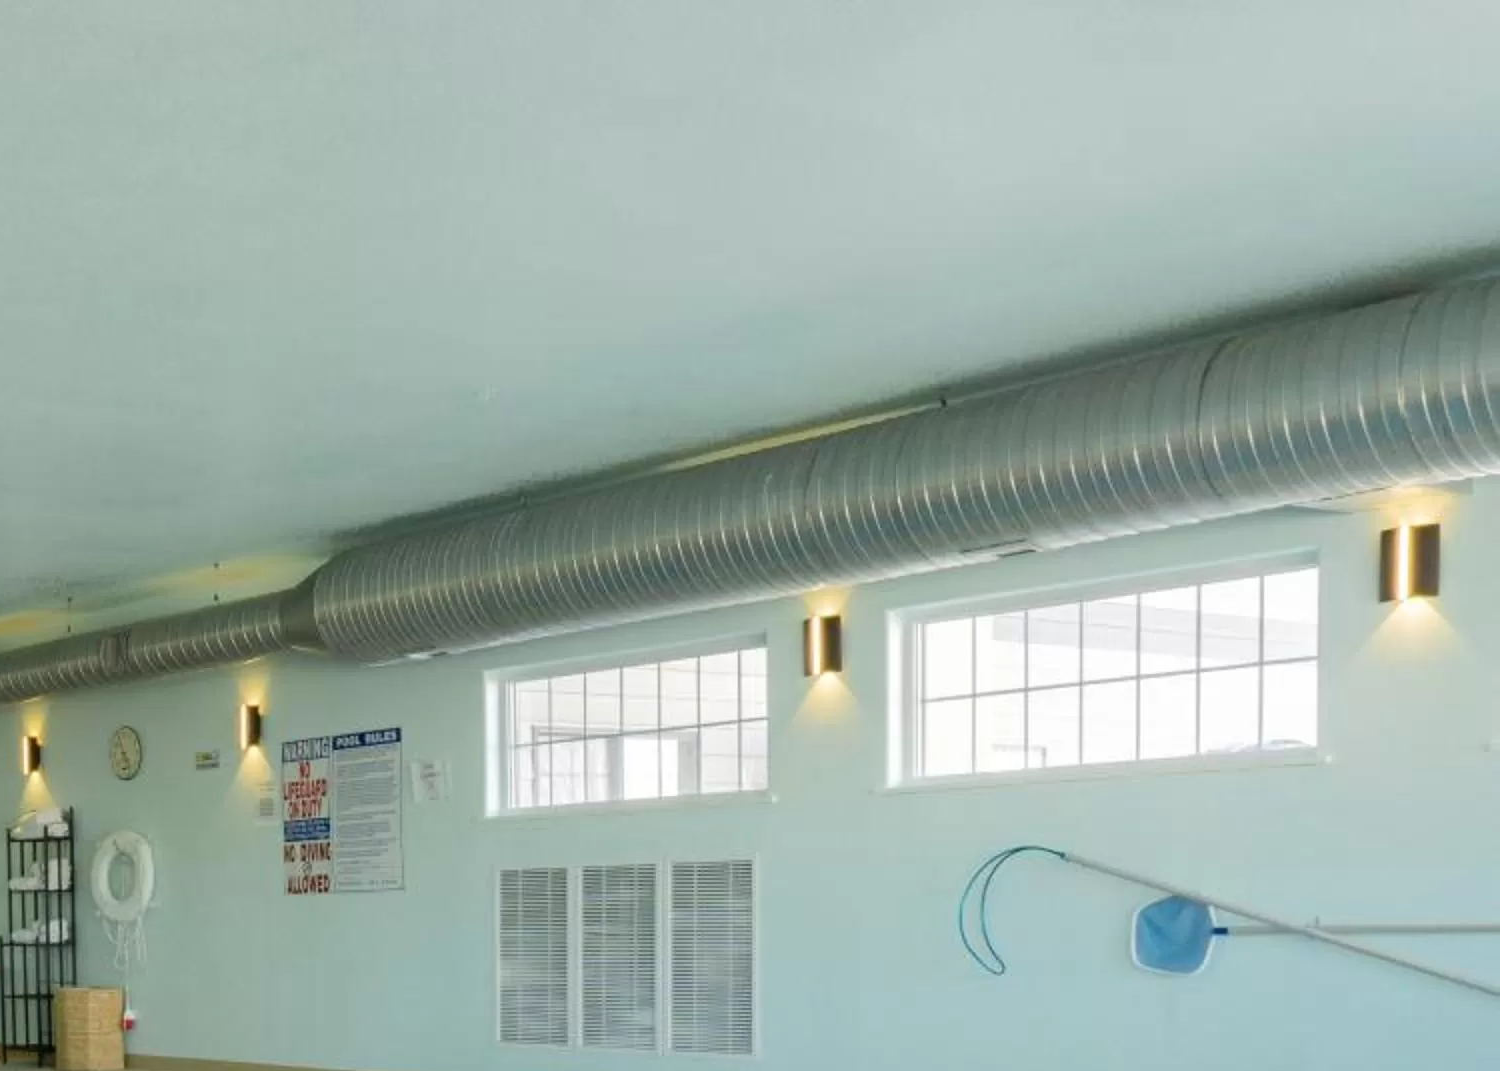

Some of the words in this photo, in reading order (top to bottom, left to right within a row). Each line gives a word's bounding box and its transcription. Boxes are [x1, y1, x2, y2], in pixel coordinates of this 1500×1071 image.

[336, 735, 360, 748] POOL
[364, 731, 397, 745] RULES
[299, 761, 311, 778] NO
[283, 779, 327, 800] LIFEGUARD
[288, 801, 300, 818] ON
[302, 799, 322, 818] DUTY
[284, 844, 295, 863] NO
[300, 842, 331, 861] DIVING
[287, 873, 331, 894] ALLOWED
